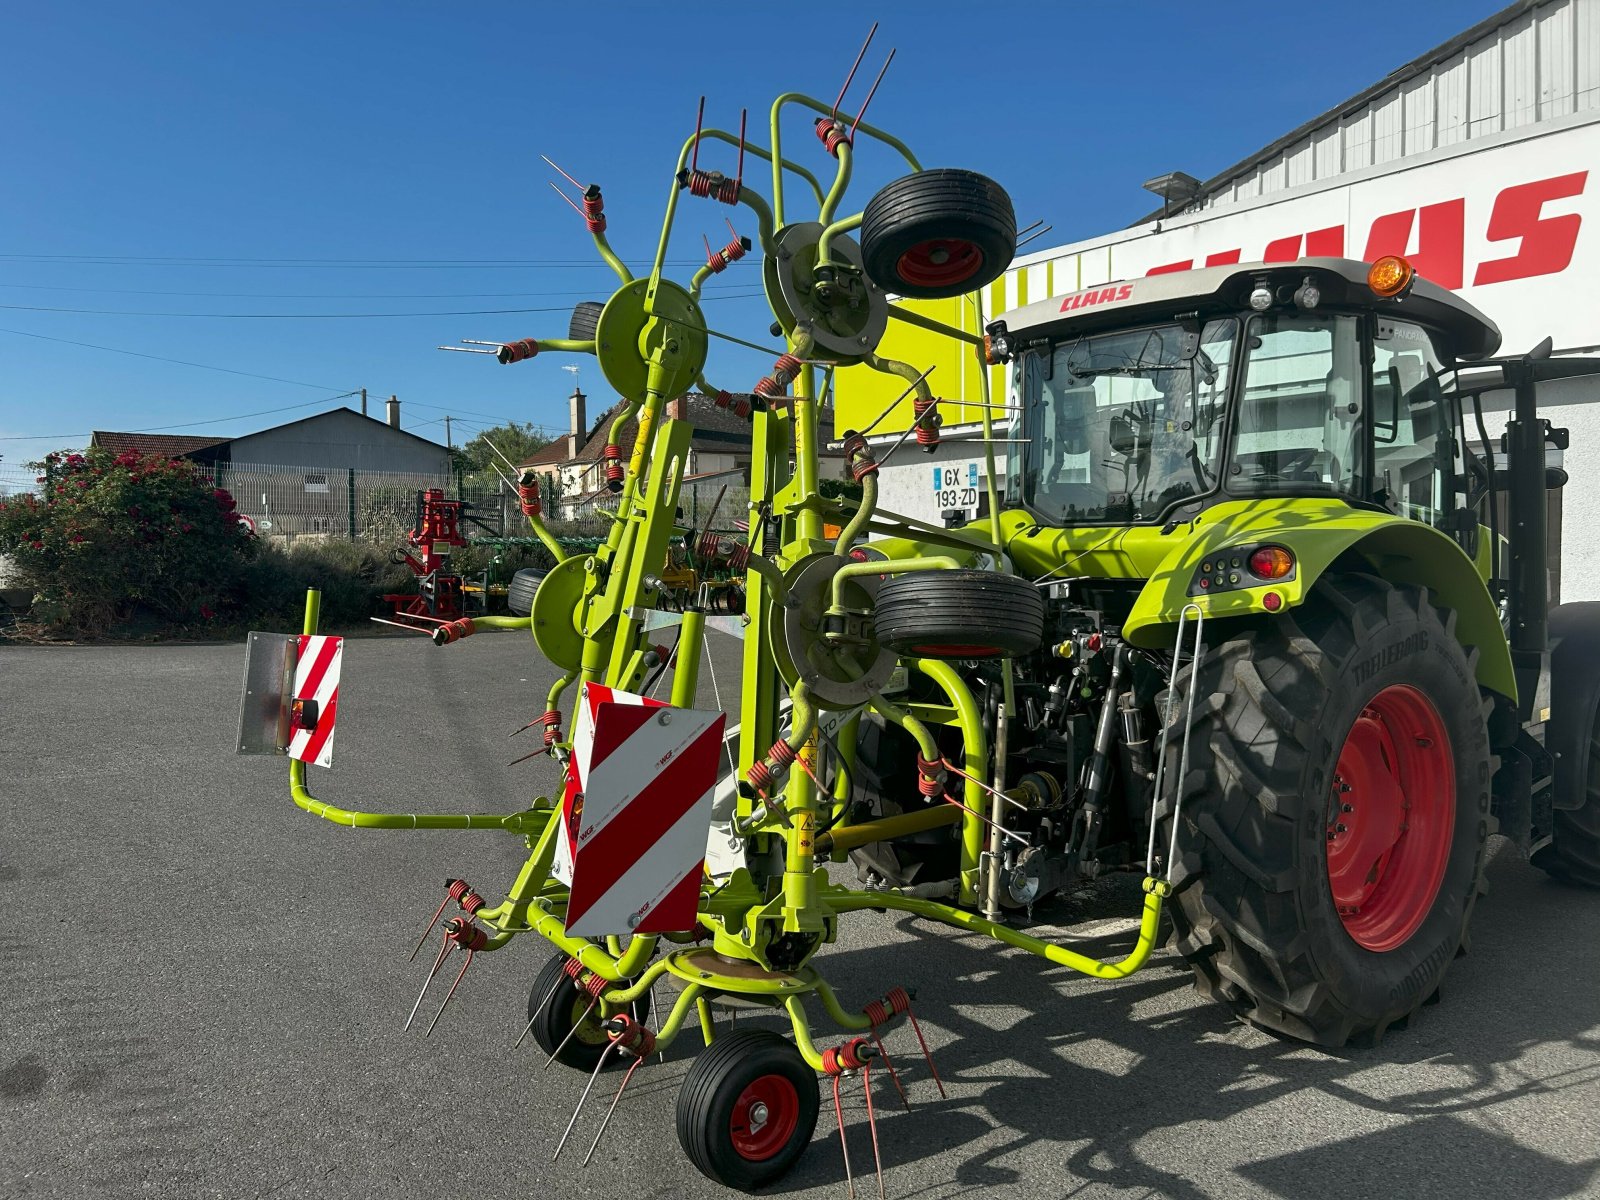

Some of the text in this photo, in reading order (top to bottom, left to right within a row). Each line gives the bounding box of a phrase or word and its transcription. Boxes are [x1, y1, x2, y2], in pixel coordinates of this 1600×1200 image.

[1059, 284, 1134, 313] CLAAS
[1351, 630, 1429, 688] TRELLEBORG
[579, 824, 596, 842] WGF
